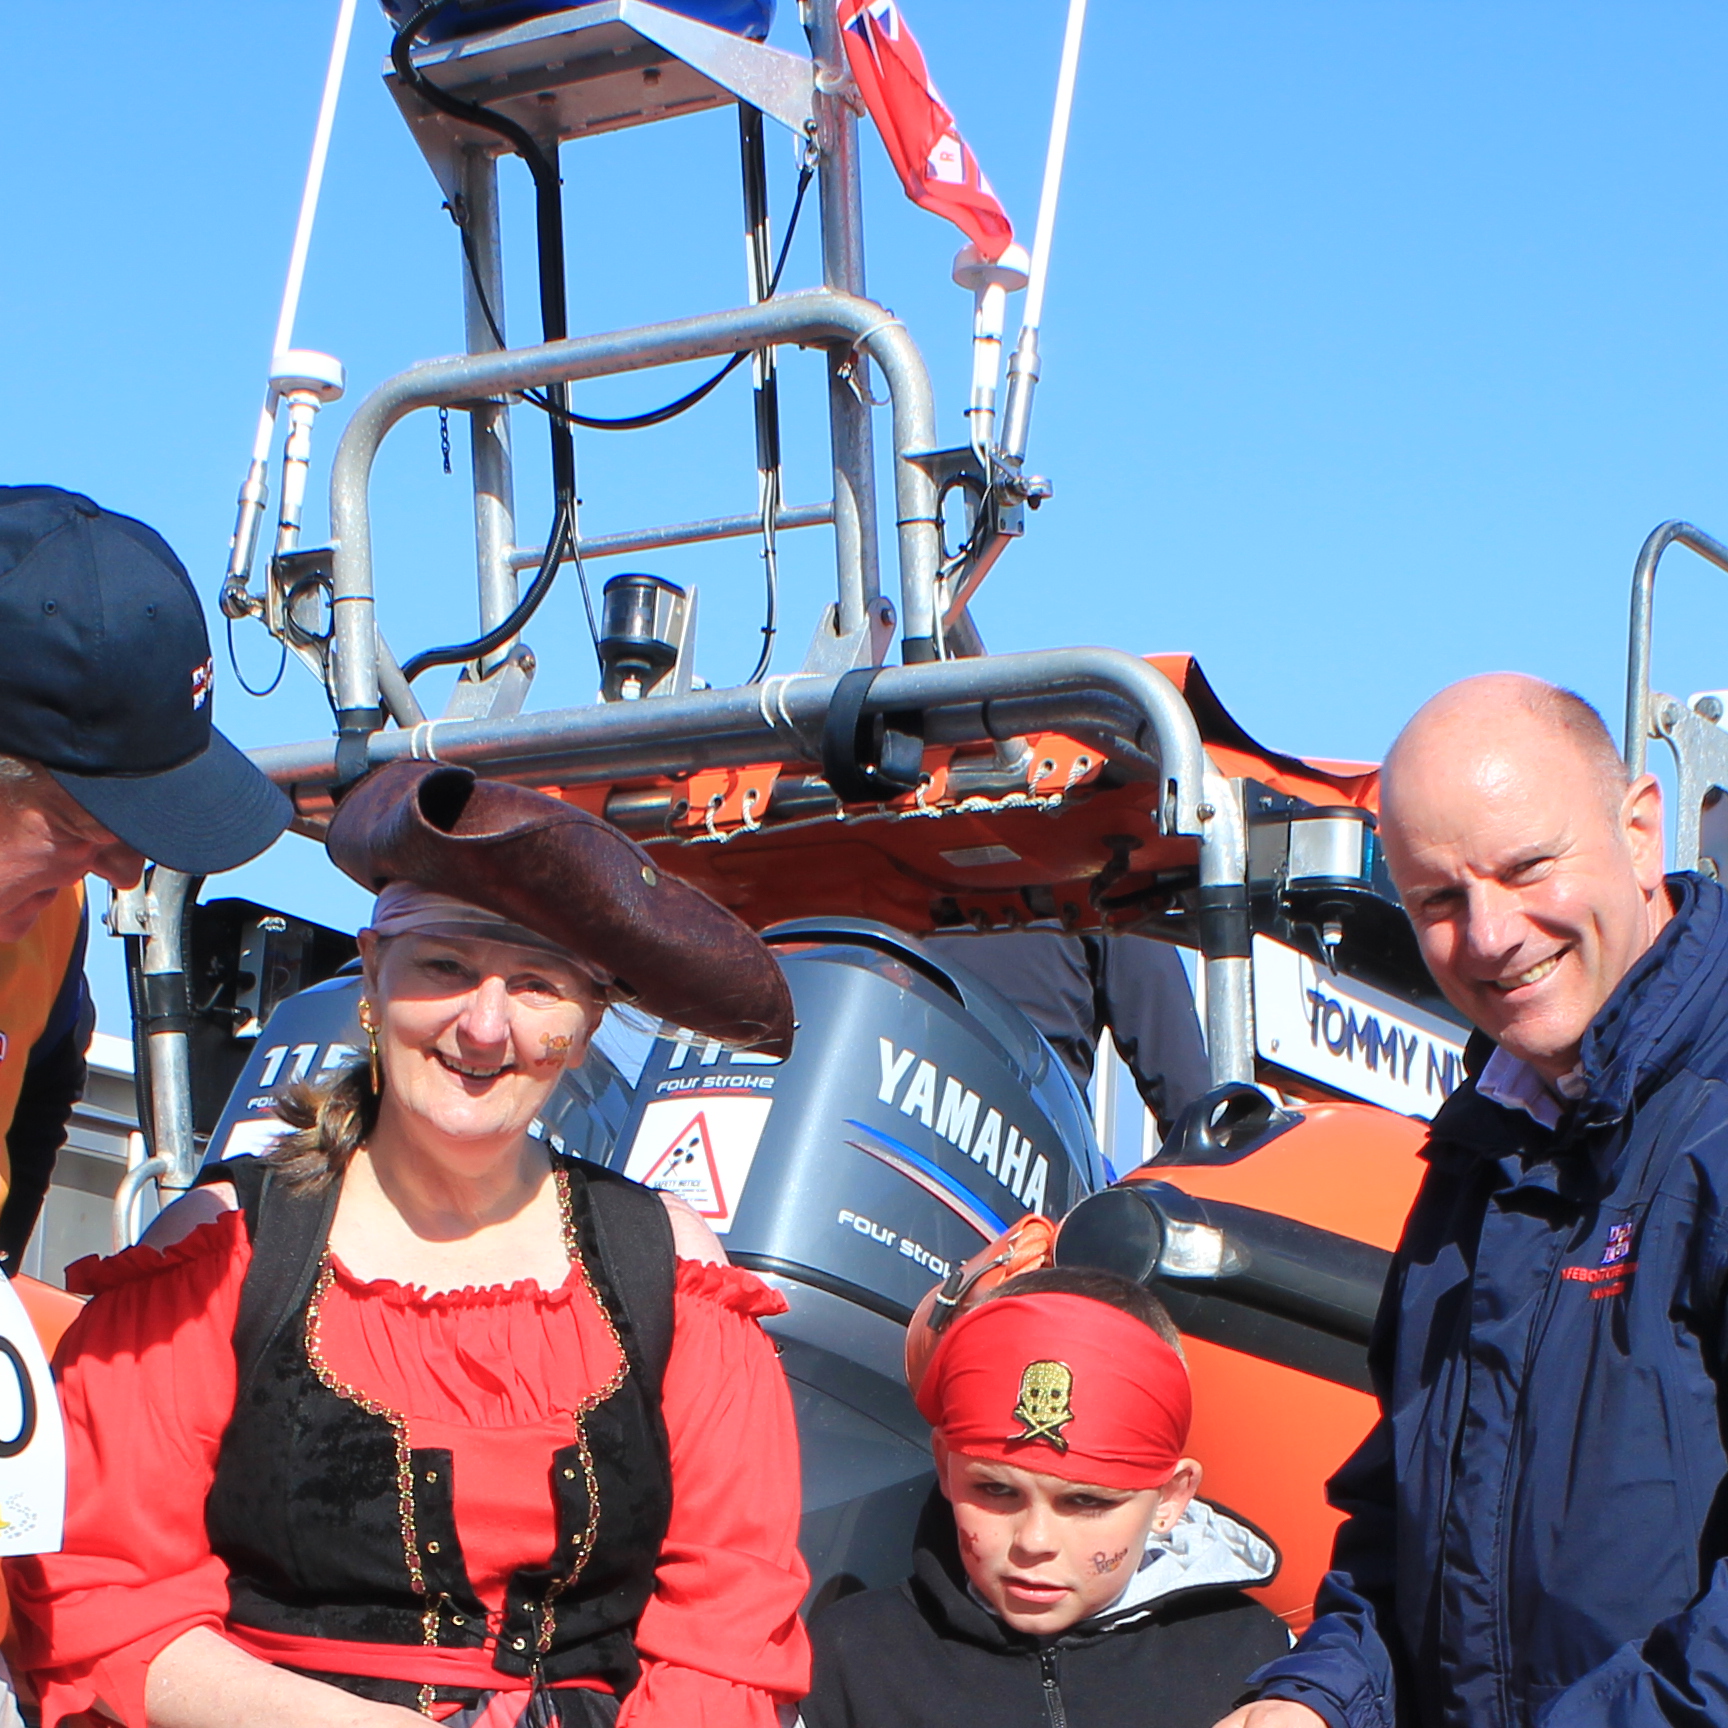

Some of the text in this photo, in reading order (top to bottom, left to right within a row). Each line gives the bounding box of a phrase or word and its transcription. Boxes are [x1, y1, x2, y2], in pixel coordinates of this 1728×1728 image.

[939, 151, 954, 162] R
[1306, 987, 1419, 1087] TOMMY
[877, 1036, 1049, 1216] YAMAHA
